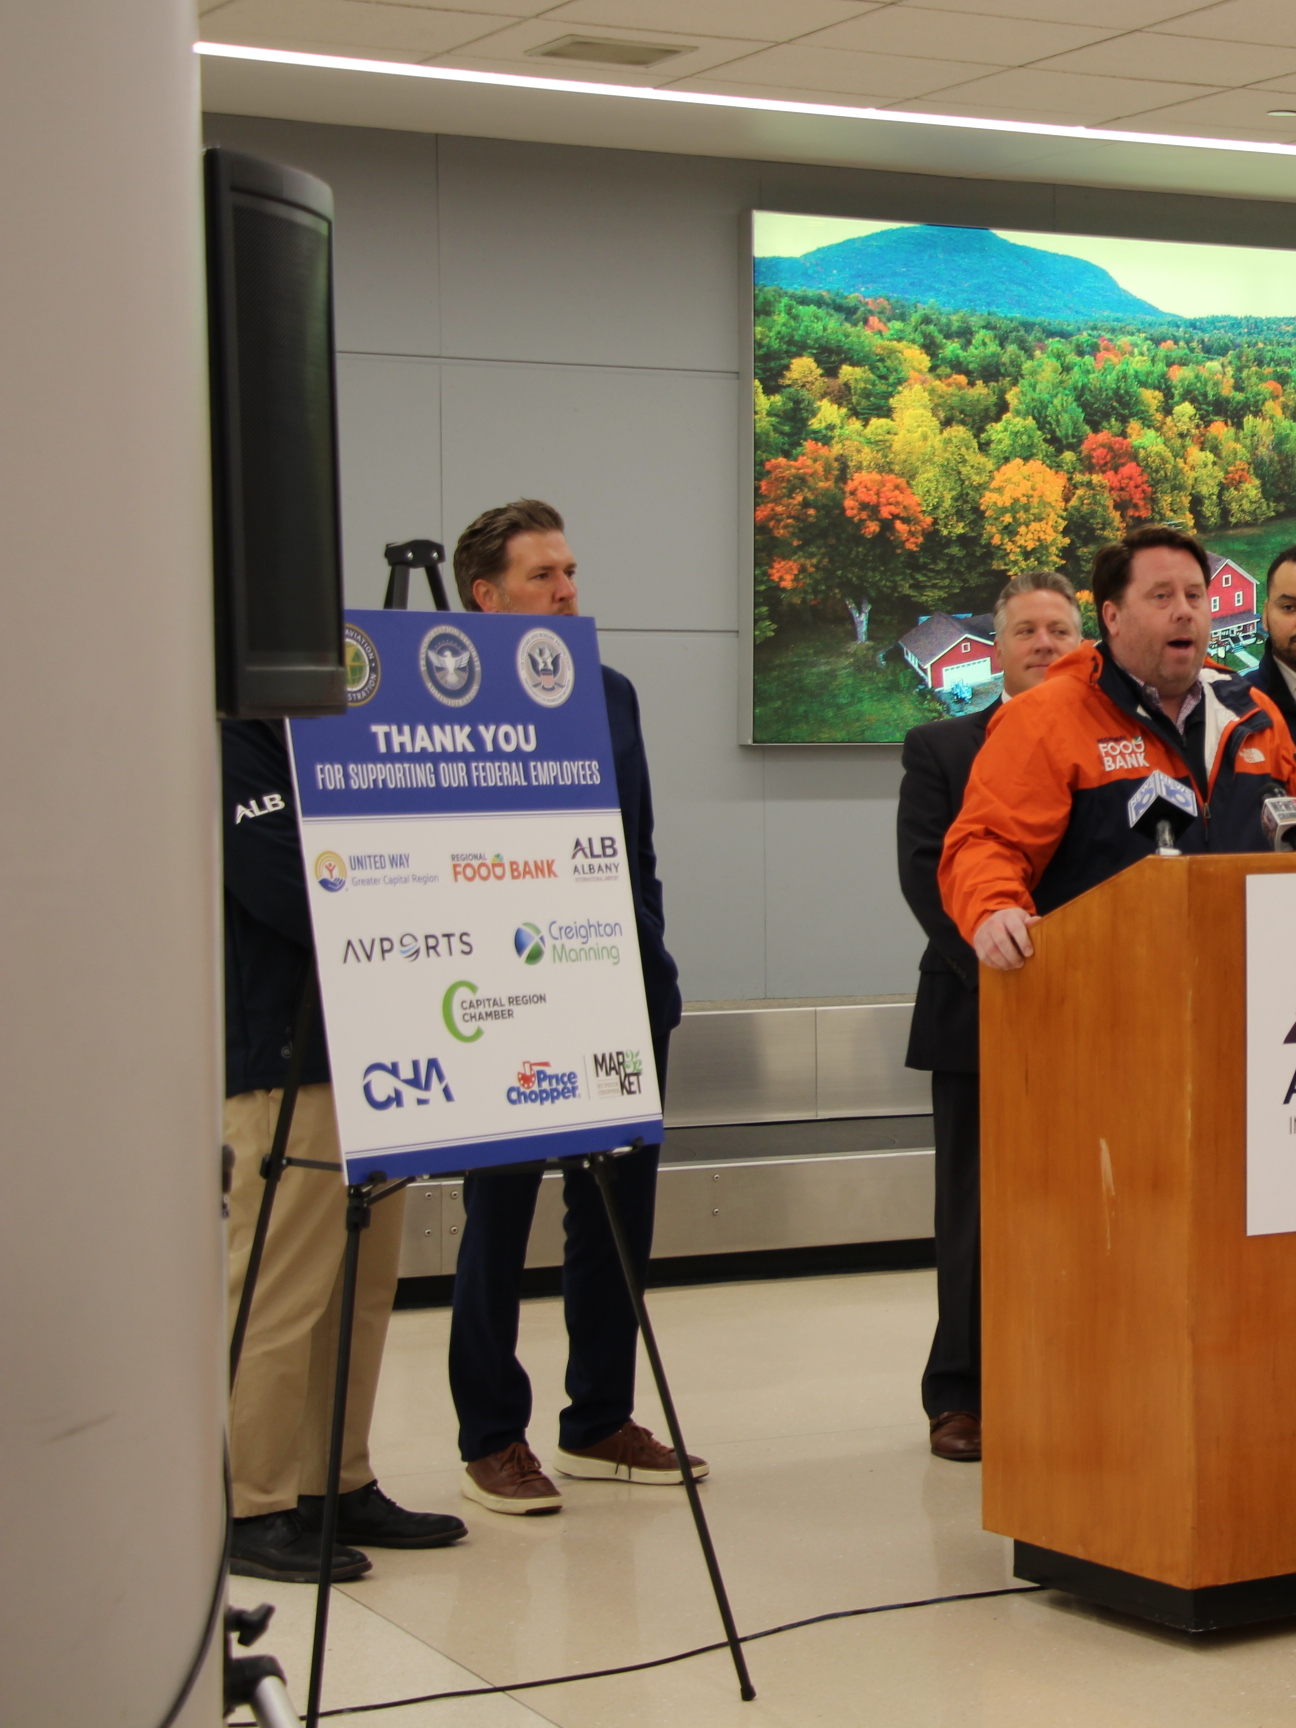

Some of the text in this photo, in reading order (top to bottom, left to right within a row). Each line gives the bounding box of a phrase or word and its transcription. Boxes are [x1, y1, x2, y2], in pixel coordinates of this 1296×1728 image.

[370, 724, 538, 753] THANK YOU
[1098, 740, 1145, 757] FOOD
[1104, 753, 1150, 771] BANK
[316, 760, 601, 790] FOR SUPPORTING OUR FEDERAL EMPLOYEES
[235, 793, 286, 825] ALB
[450, 853, 487, 862] REGIONAL
[571, 836, 619, 860] ALB
[349, 853, 410, 871] UNITED WAY
[452, 859, 559, 882] FOOD BANK
[573, 862, 620, 875] ALBANY
[351, 872, 440, 887] Greater Capital Region
[548, 918, 623, 945] Creighton
[343, 931, 474, 964] AVPORTS
[552, 942, 622, 966] Manning
[460, 993, 547, 1011] CAPITAL REGION
[462, 1008, 515, 1023] CHAMBER
[535, 1068, 578, 1089] Price
[506, 1084, 579, 1106] Chopper
